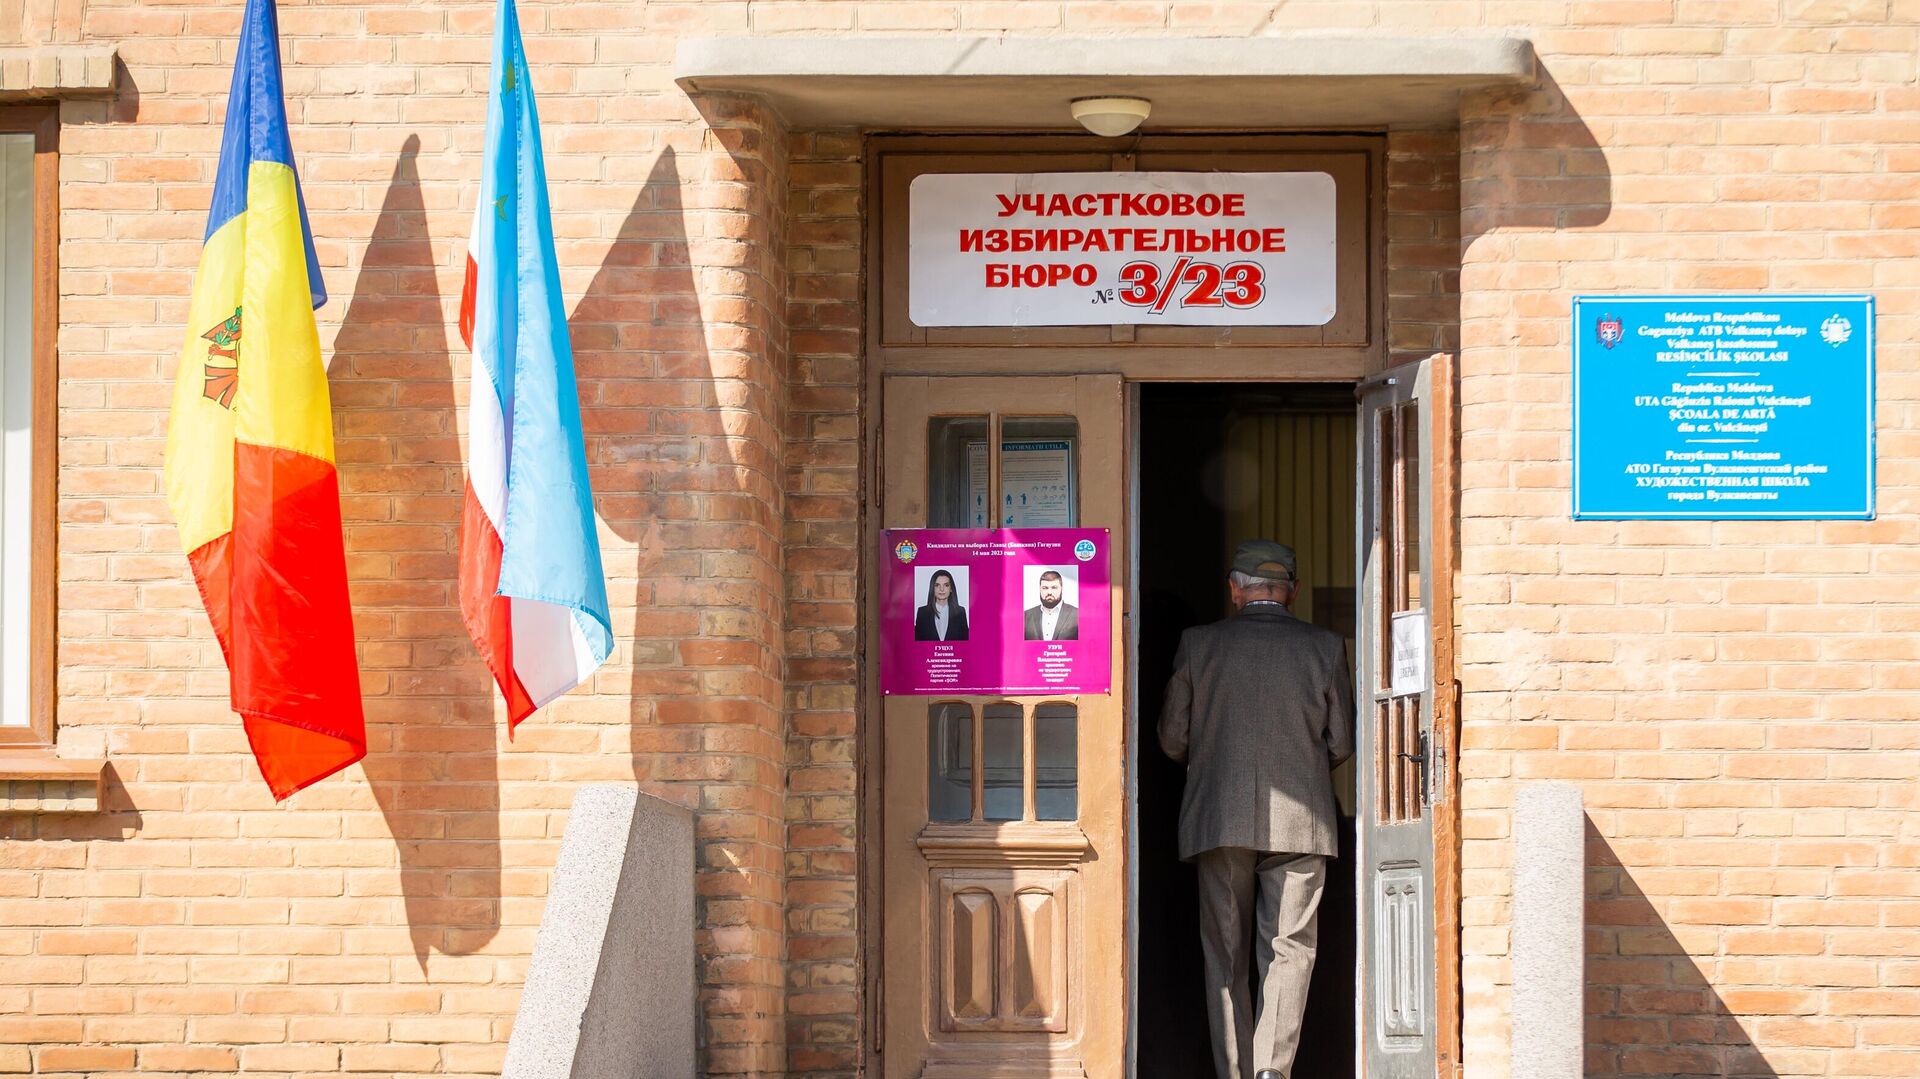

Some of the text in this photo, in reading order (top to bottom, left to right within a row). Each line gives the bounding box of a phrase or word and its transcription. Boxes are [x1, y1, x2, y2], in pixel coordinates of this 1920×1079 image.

[995, 193, 1246, 217] УЧАСТКОВОЕ
[959, 227, 1286, 252] ИЗБИРАТЕЛЬНОЕ
[985, 256, 1267, 315] БЮРО № 3/23
[1665, 313, 1711, 322] Moldova
[1657, 350, 1788, 363] RESİMCİLİK ŞKOLASI
[1672, 383, 1773, 395] Republica Moldova
[1635, 397, 1659, 405] UTA
[1669, 407, 1775, 421] ŞCOALA DE ARTĂ
[1678, 423, 1695, 432] din
[1666, 451, 1780, 462] Республика Молдова
[1625, 464, 1651, 473] АТО
[1794, 464, 1827, 475] район
[1636, 477, 1809, 487] ХУДОЖЕСТВЕННАЯ ШКОЛА
[1668, 492, 1704, 502] города
